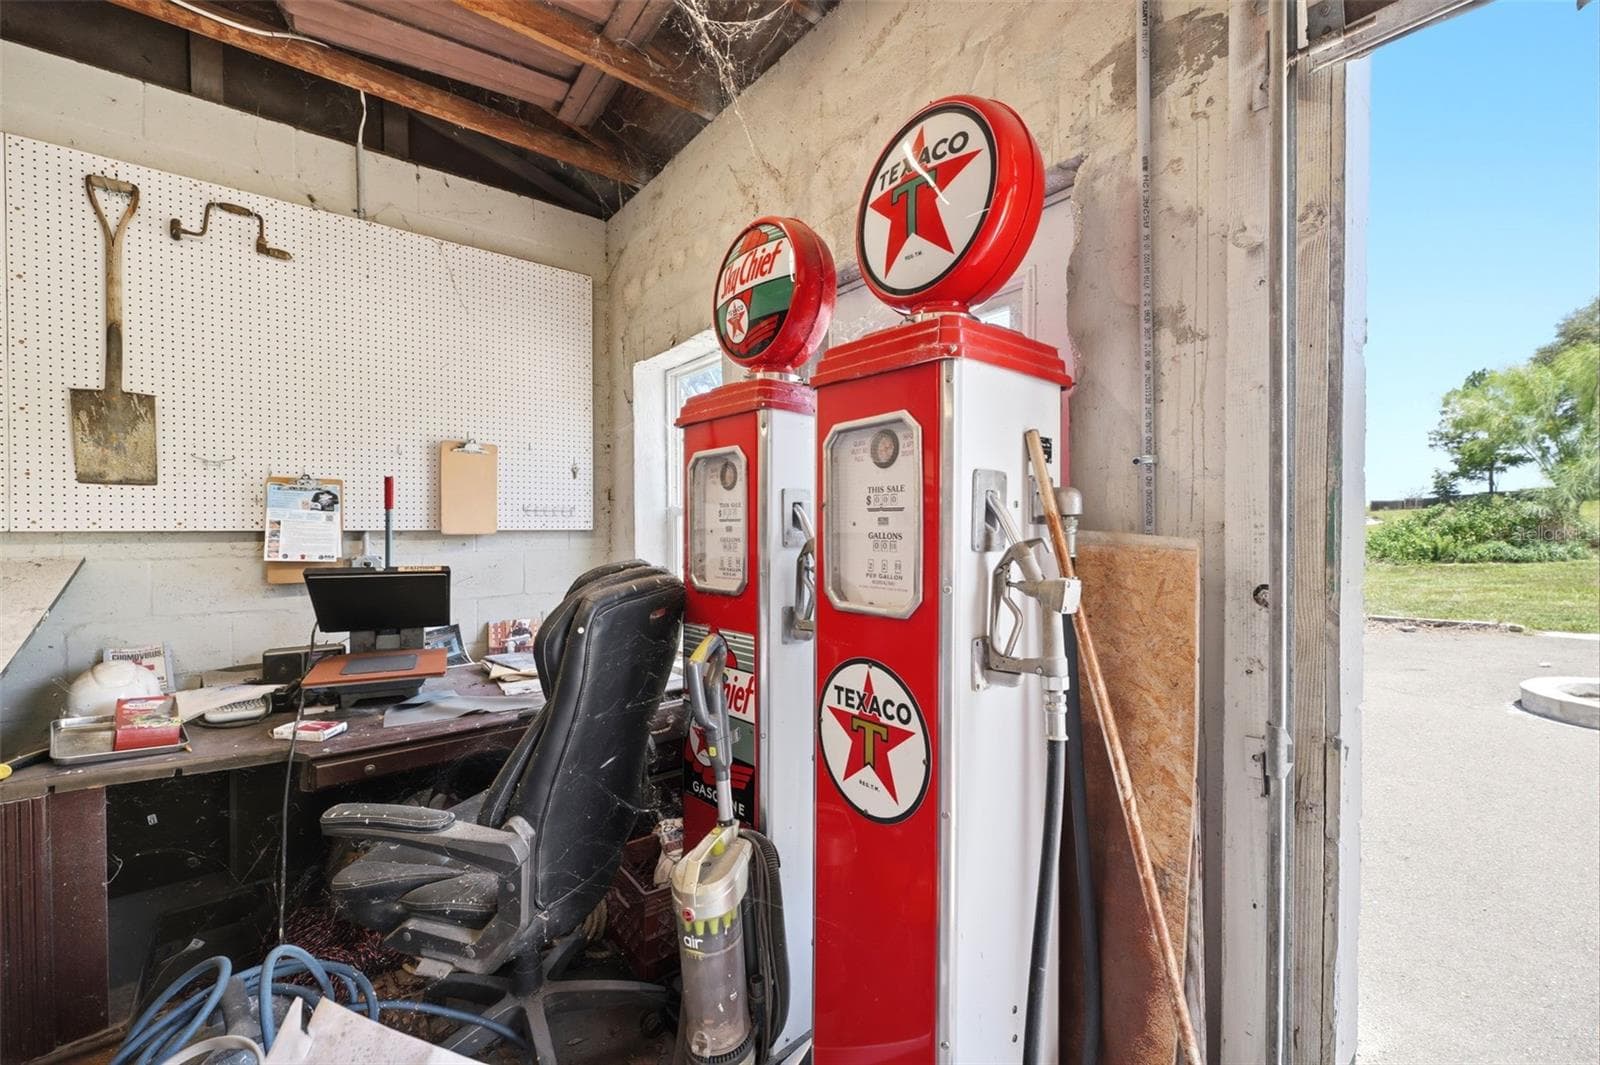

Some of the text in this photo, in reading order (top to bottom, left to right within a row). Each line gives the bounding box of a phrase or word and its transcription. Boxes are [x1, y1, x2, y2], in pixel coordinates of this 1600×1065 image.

[880, 131, 969, 191] TEXACO
[740, 240, 783, 285] Chief
[868, 484, 906, 494] THIS SALE
[868, 531, 903, 541] GALLONS
[878, 573, 903, 581] GALLON
[834, 685, 912, 725] TEXACO
[683, 935, 704, 950] air
